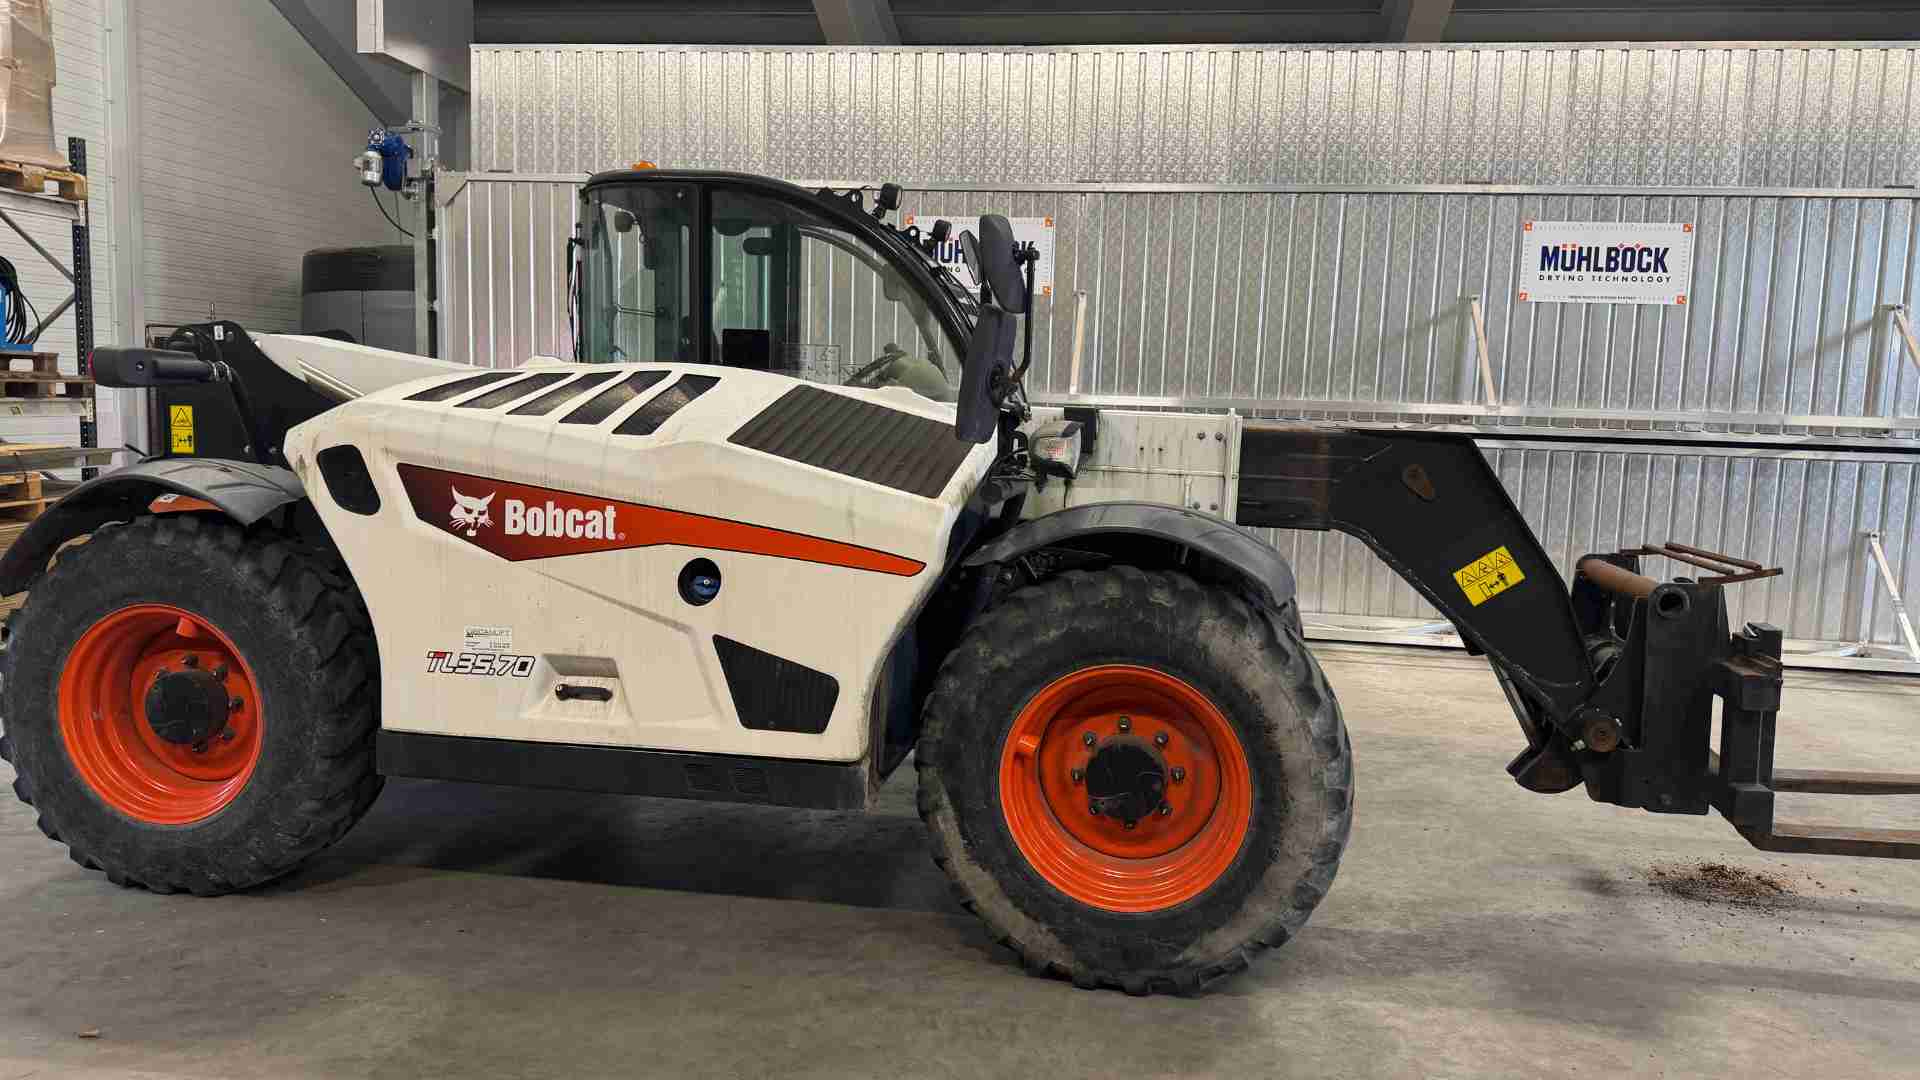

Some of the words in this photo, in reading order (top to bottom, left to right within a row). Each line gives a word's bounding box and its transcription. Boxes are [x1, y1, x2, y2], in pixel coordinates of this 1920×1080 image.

[1540, 243, 1670, 273] MÜHLBÖCK
[1539, 274, 1584, 282] DRYING
[1592, 275, 1672, 283] TECHNOLOGY
[504, 499, 617, 541] Bobcat
[426, 651, 536, 678] TL35.70
